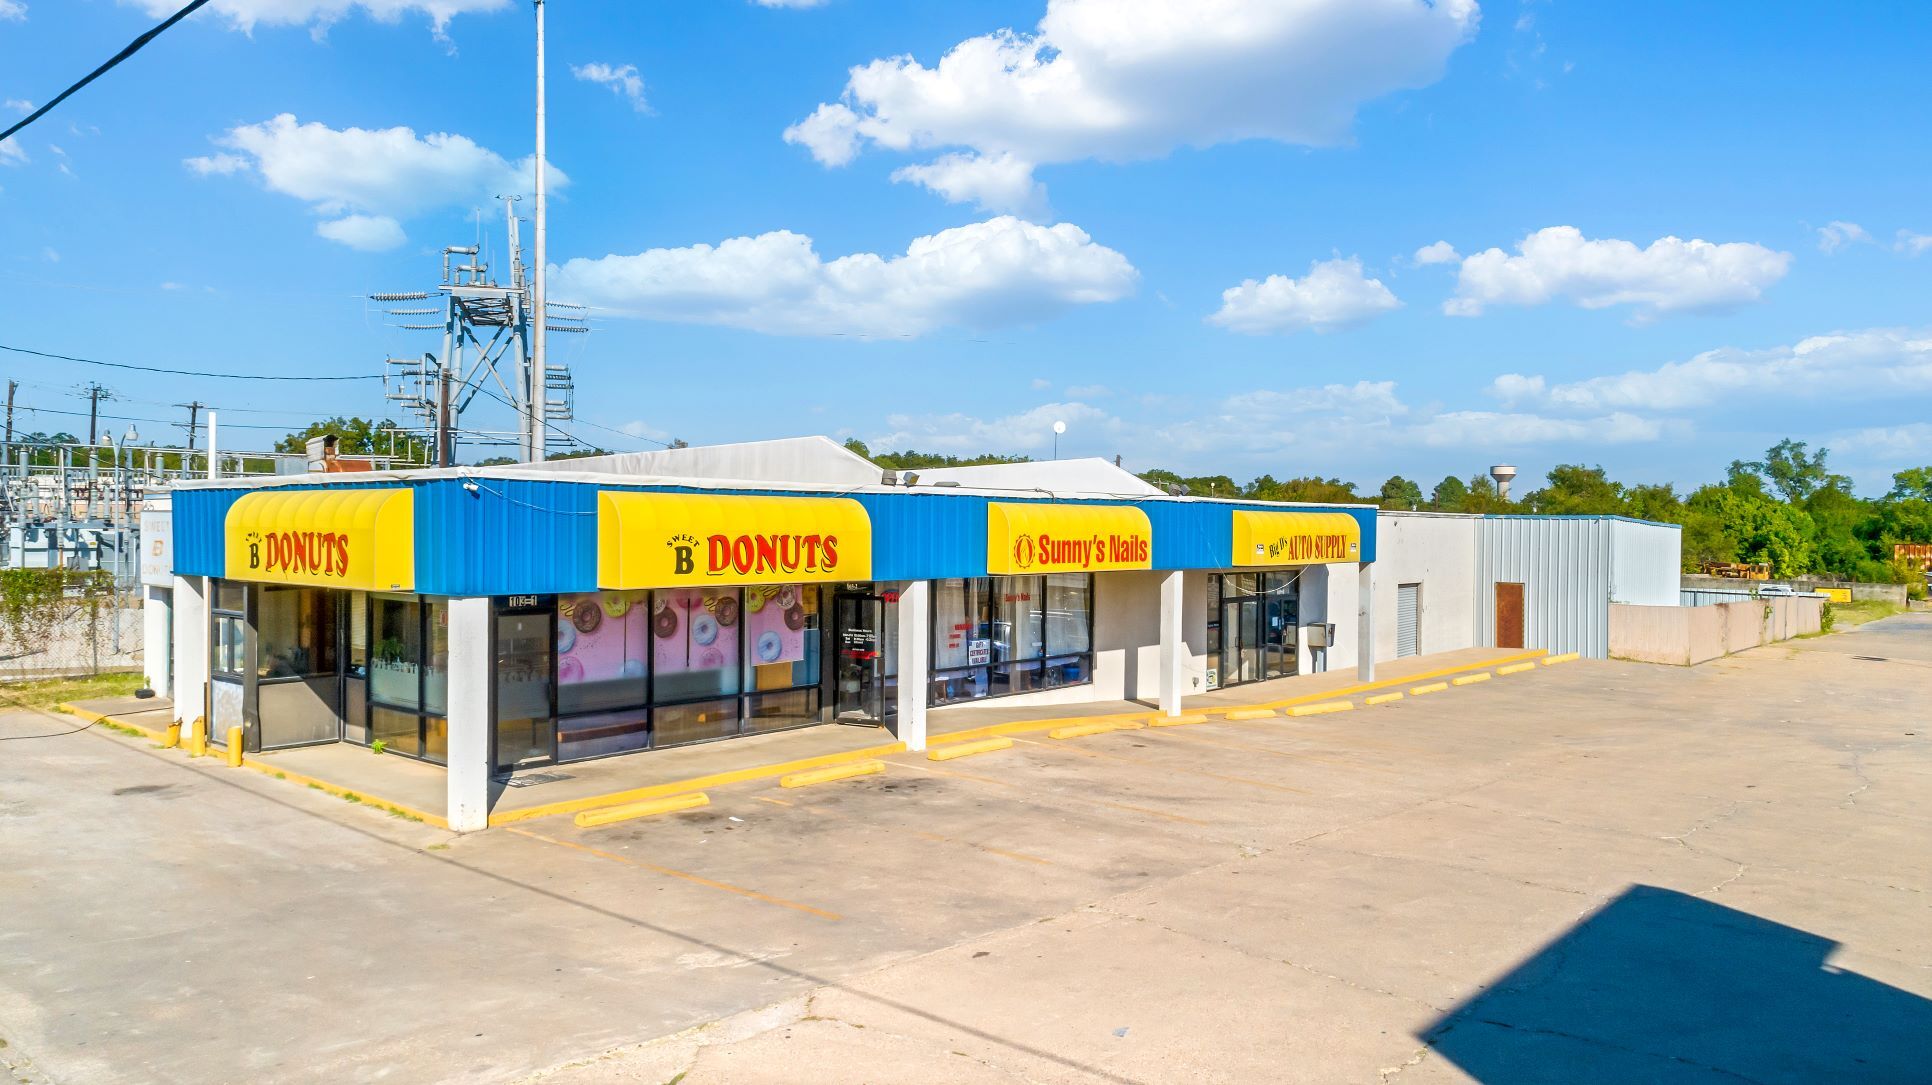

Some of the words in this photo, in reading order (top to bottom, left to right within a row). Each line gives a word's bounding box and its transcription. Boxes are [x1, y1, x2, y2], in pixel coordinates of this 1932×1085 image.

[249, 542, 260, 569] B
[265, 530, 349, 577] DONUTS
[666, 533, 700, 548] SWEET
[674, 545, 695, 575] B
[706, 534, 838, 576] DONUTS
[1038, 534, 1106, 569] Sunny's
[1109, 534, 1148, 563] Nails
[1288, 534, 1313, 560] AUTO
[1314, 534, 1347, 559] SUPPLY
